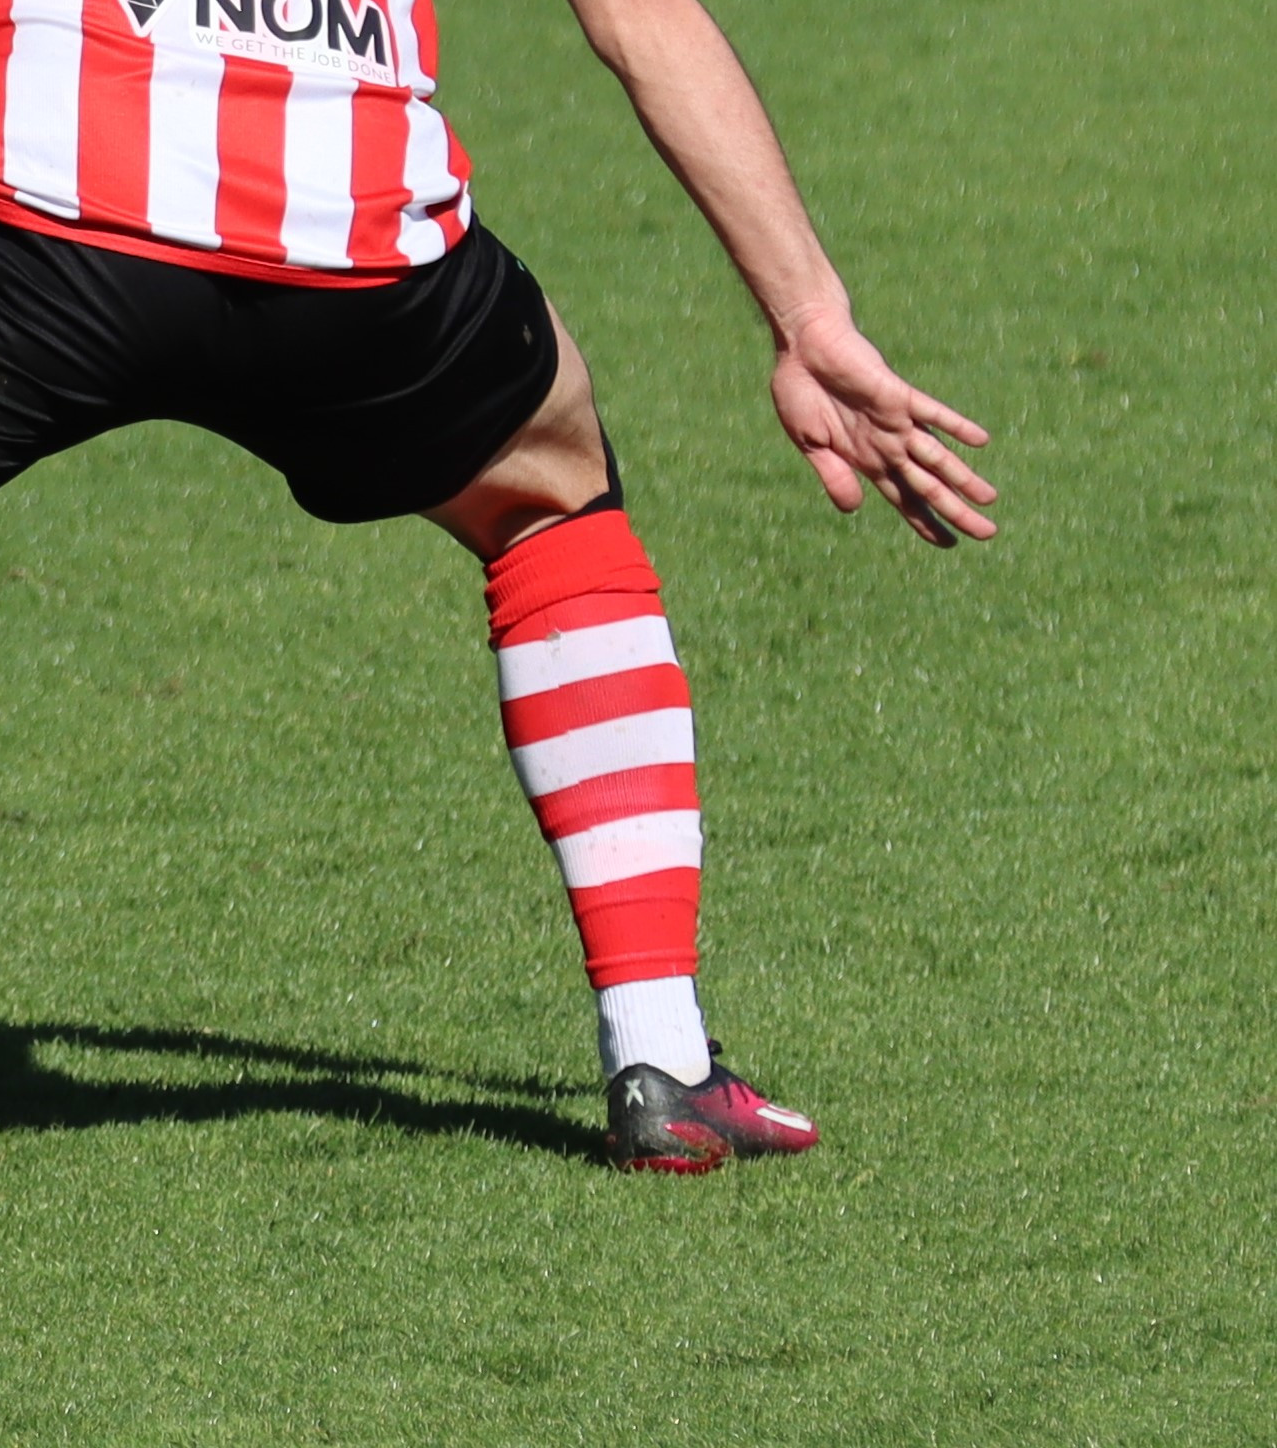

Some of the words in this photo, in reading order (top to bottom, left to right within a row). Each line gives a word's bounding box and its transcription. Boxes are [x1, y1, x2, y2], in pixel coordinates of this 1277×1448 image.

[195, 32, 225, 49] WE
[231, 37, 266, 55] GET
[271, 44, 307, 61] THE
[310, 51, 343, 69] JOB
[347, 59, 392, 84] DONE
